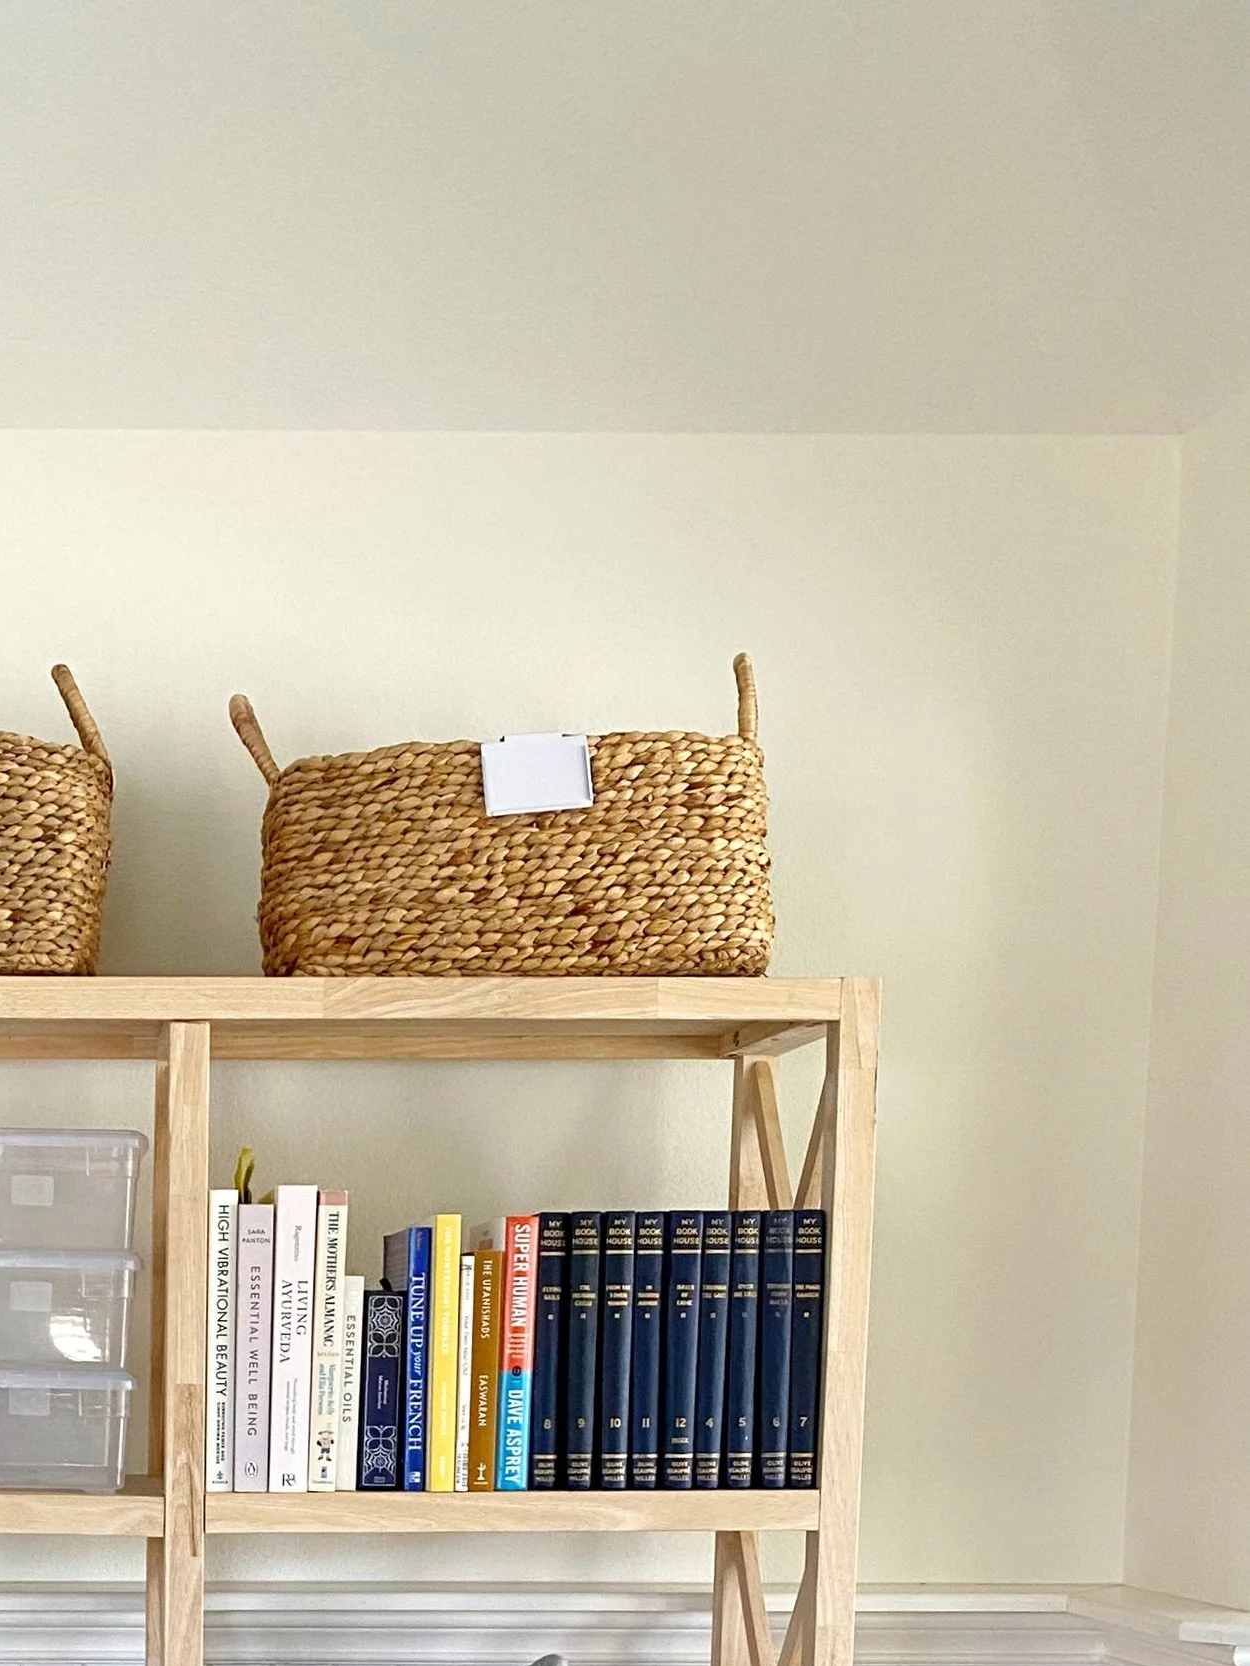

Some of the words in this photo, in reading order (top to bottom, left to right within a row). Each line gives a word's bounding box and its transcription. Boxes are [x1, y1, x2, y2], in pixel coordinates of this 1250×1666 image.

[218, 1204, 230, 1243] HIGH
[328, 1211, 339, 1234] THE
[575, 1228, 597, 1236] BOOK
[676, 1227, 699, 1235] BOOK
[706, 1227, 729, 1235] BOOK
[738, 1227, 759, 1235] BOOK
[798, 1227, 821, 1235] BOOK
[512, 1223, 531, 1271] SUPER
[606, 1237, 632, 1245] HOUSE
[637, 1237, 662, 1245] HOUSE
[673, 1237, 701, 1245] HOUSE
[795, 1237, 823, 1245] HOUSE
[325, 1237, 338, 1291] MOTHER'S
[482, 1259, 492, 1275] THE
[216, 1246, 230, 1339] VIBRATIONAL
[410, 1272, 425, 1321] TUNE
[510, 1276, 529, 1327] HUMAN
[250, 1266, 261, 1344] ESSENTIAL
[296, 1280, 309, 1336] LIVING
[480, 1279, 491, 1339] UPANISHADS
[279, 1279, 294, 1364] AYURVEDA
[323, 1293, 336, 1347] ALMANAC
[410, 1325, 424, 1347] UP
[343, 1315, 355, 1386] ESSENTIAL
[215, 1345, 227, 1397] BEAUTY
[248, 1350, 259, 1385] WELL
[410, 1350, 421, 1376] your
[341, 1392, 352, 1423] OILS
[478, 1374, 488, 1427] EASWARAN
[506, 1389, 523, 1424] DAVE
[246, 1393, 257, 1437] BEING
[407, 1378, 423, 1450] FRENCH
[543, 1418, 552, 1429] 8
[577, 1418, 586, 1428] 9
[609, 1417, 622, 1428] 10
[641, 1417, 650, 1428] 11
[675, 1417, 687, 1428] 12
[705, 1417, 714, 1428] 4
[738, 1416, 747, 1427] 5
[772, 1416, 781, 1427] 6
[799, 1416, 808, 1427] 7
[503, 1428, 521, 1483] ASPREY
